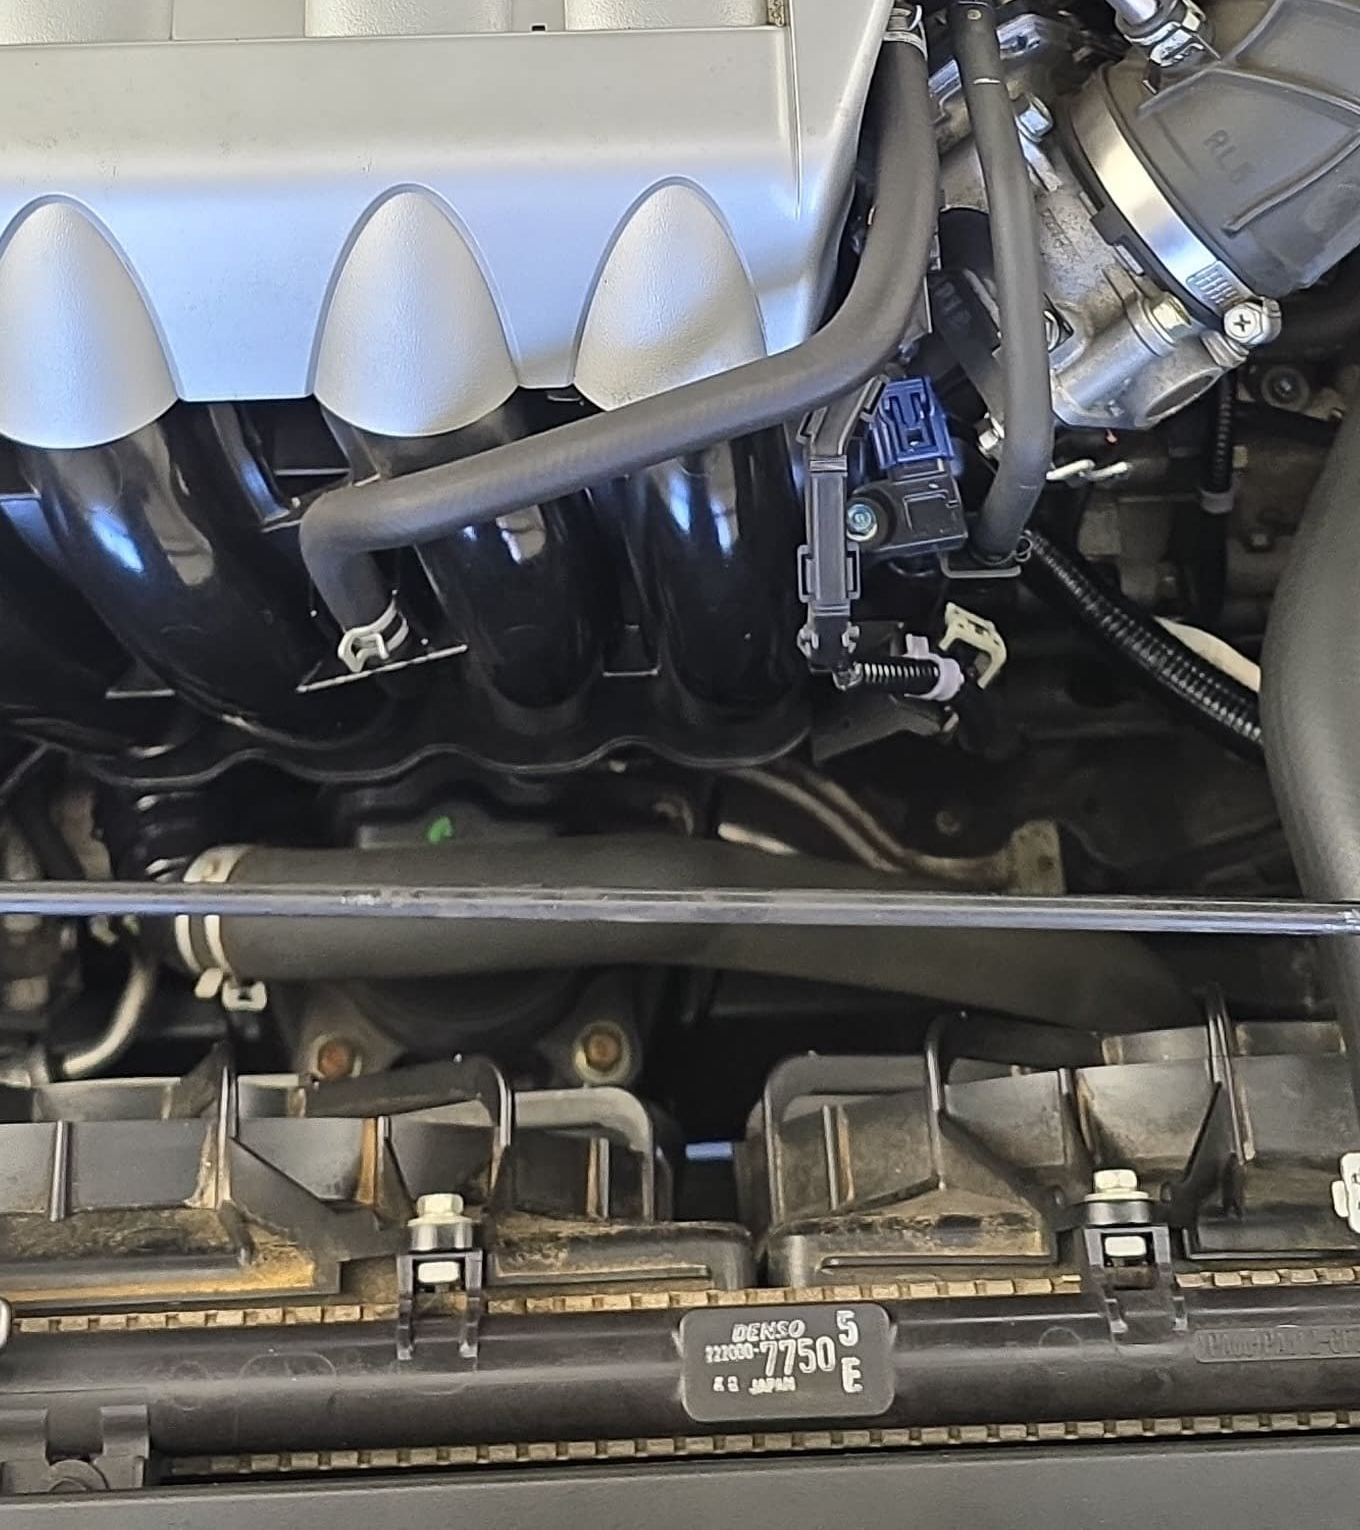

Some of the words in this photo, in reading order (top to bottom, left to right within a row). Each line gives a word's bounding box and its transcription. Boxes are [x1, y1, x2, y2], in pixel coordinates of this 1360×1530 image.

[731, 1319, 806, 1343] DENSO
[835, 1309, 860, 1347] 5
[748, 1375, 797, 1395] JAPAN
[840, 1356, 865, 1394] E
